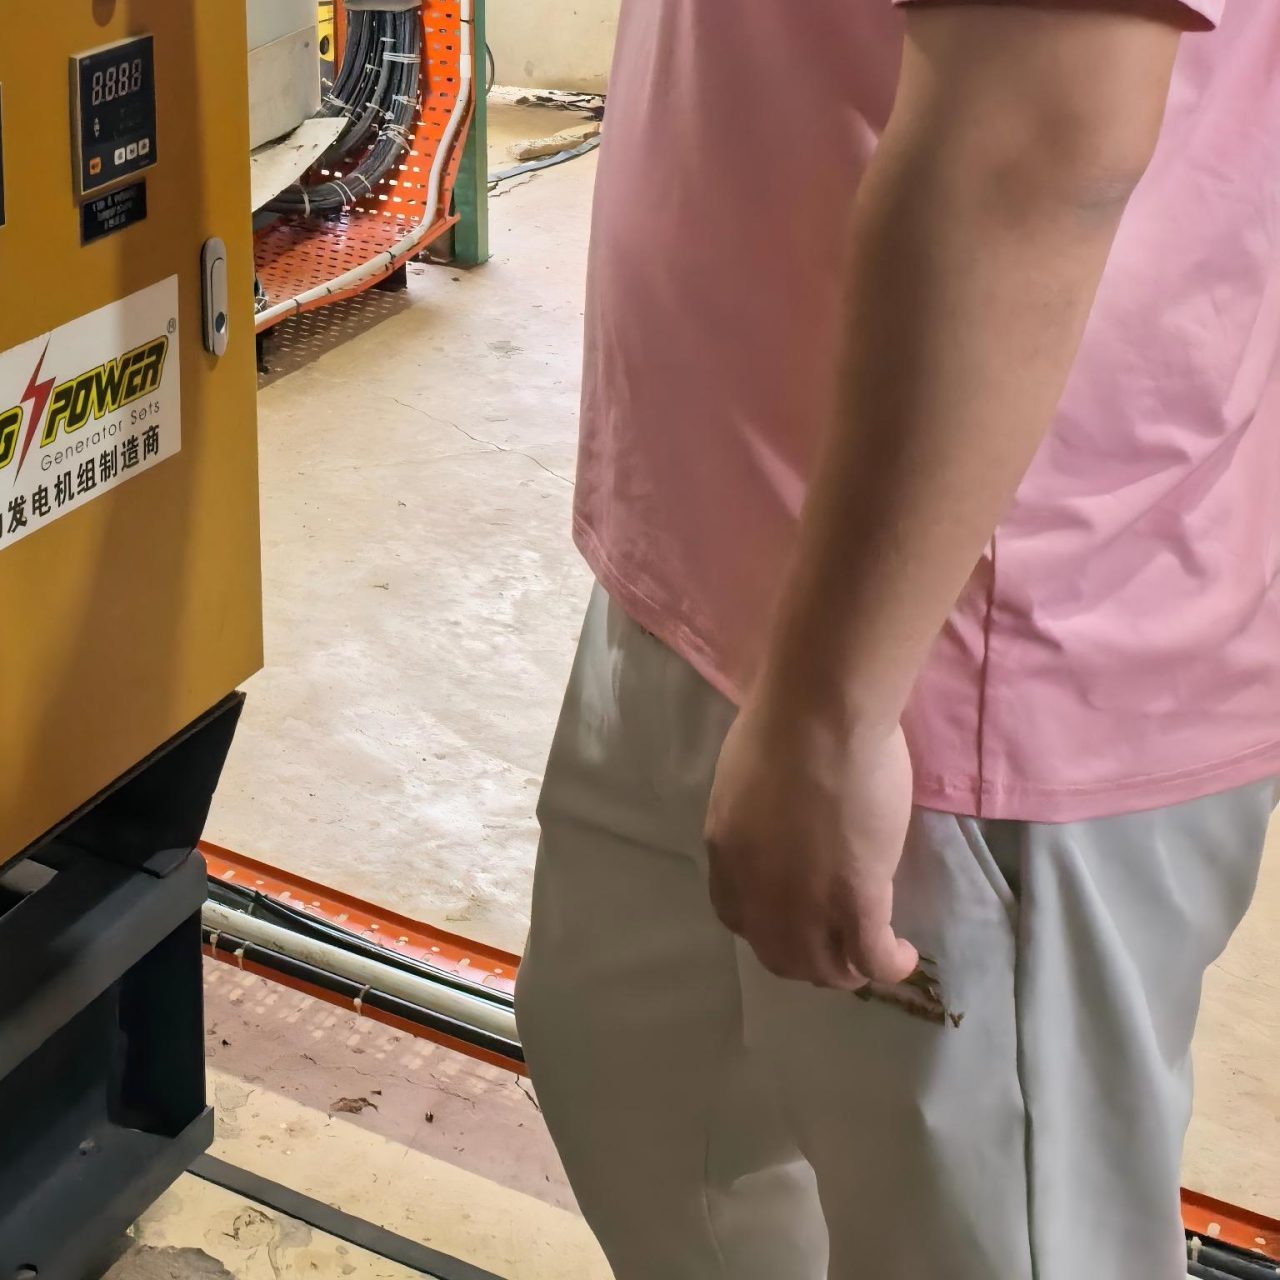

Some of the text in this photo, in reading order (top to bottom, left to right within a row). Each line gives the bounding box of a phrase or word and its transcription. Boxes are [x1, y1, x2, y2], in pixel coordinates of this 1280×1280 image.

[40, 335, 168, 448] POWER
[41, 400, 161, 471] Generator Sets
